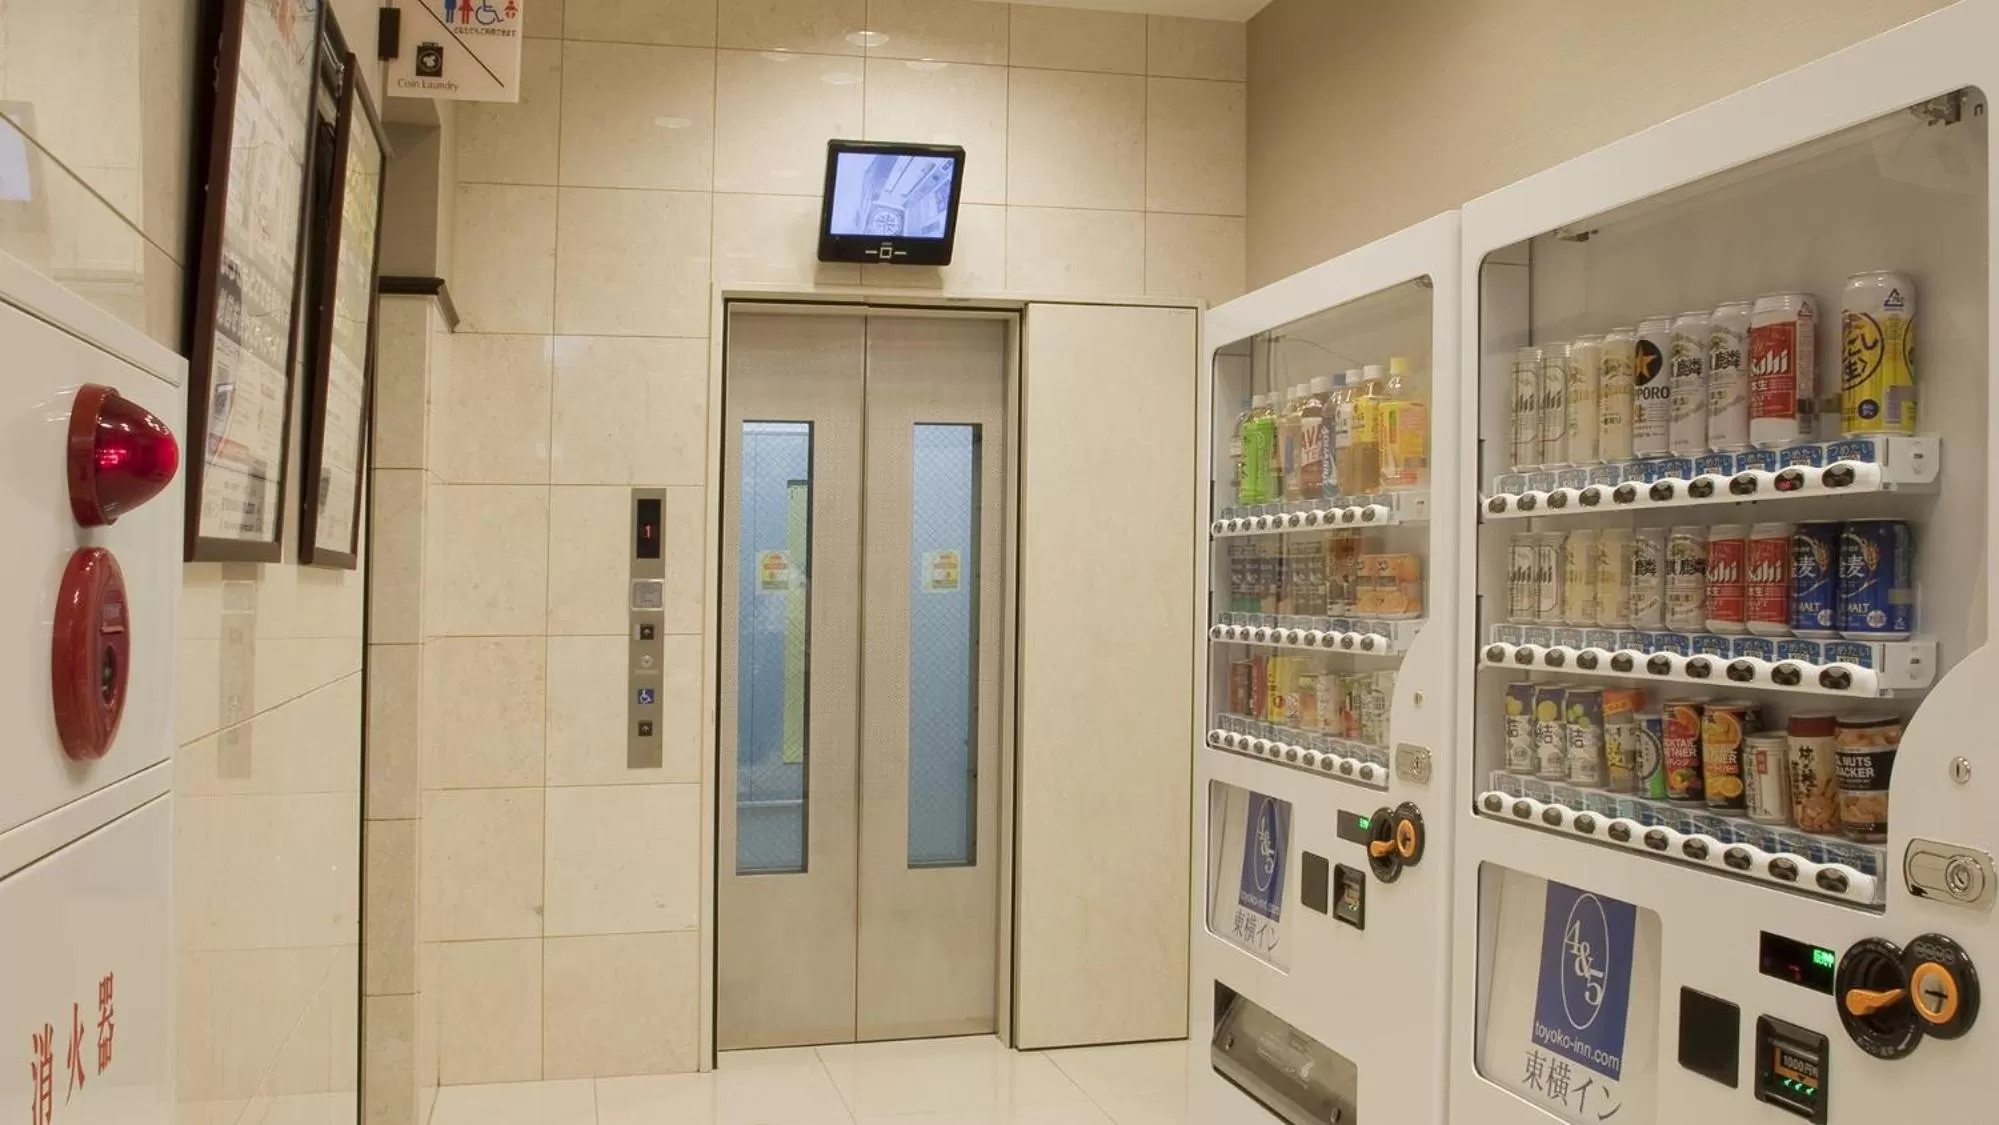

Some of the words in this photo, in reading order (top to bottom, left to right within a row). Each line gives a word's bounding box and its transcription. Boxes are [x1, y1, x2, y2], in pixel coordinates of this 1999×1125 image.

[397, 79, 419, 89] Coin
[421, 81, 459, 92] Laundry
[1843, 756, 1873, 768] NUTS
[1231, 910, 1281, 952] 東横イン
[31, 969, 116, 1125] 消火器
[1535, 1019, 1621, 1073] toyoko-inn.com
[1521, 1050, 1622, 1121] 東横イン
